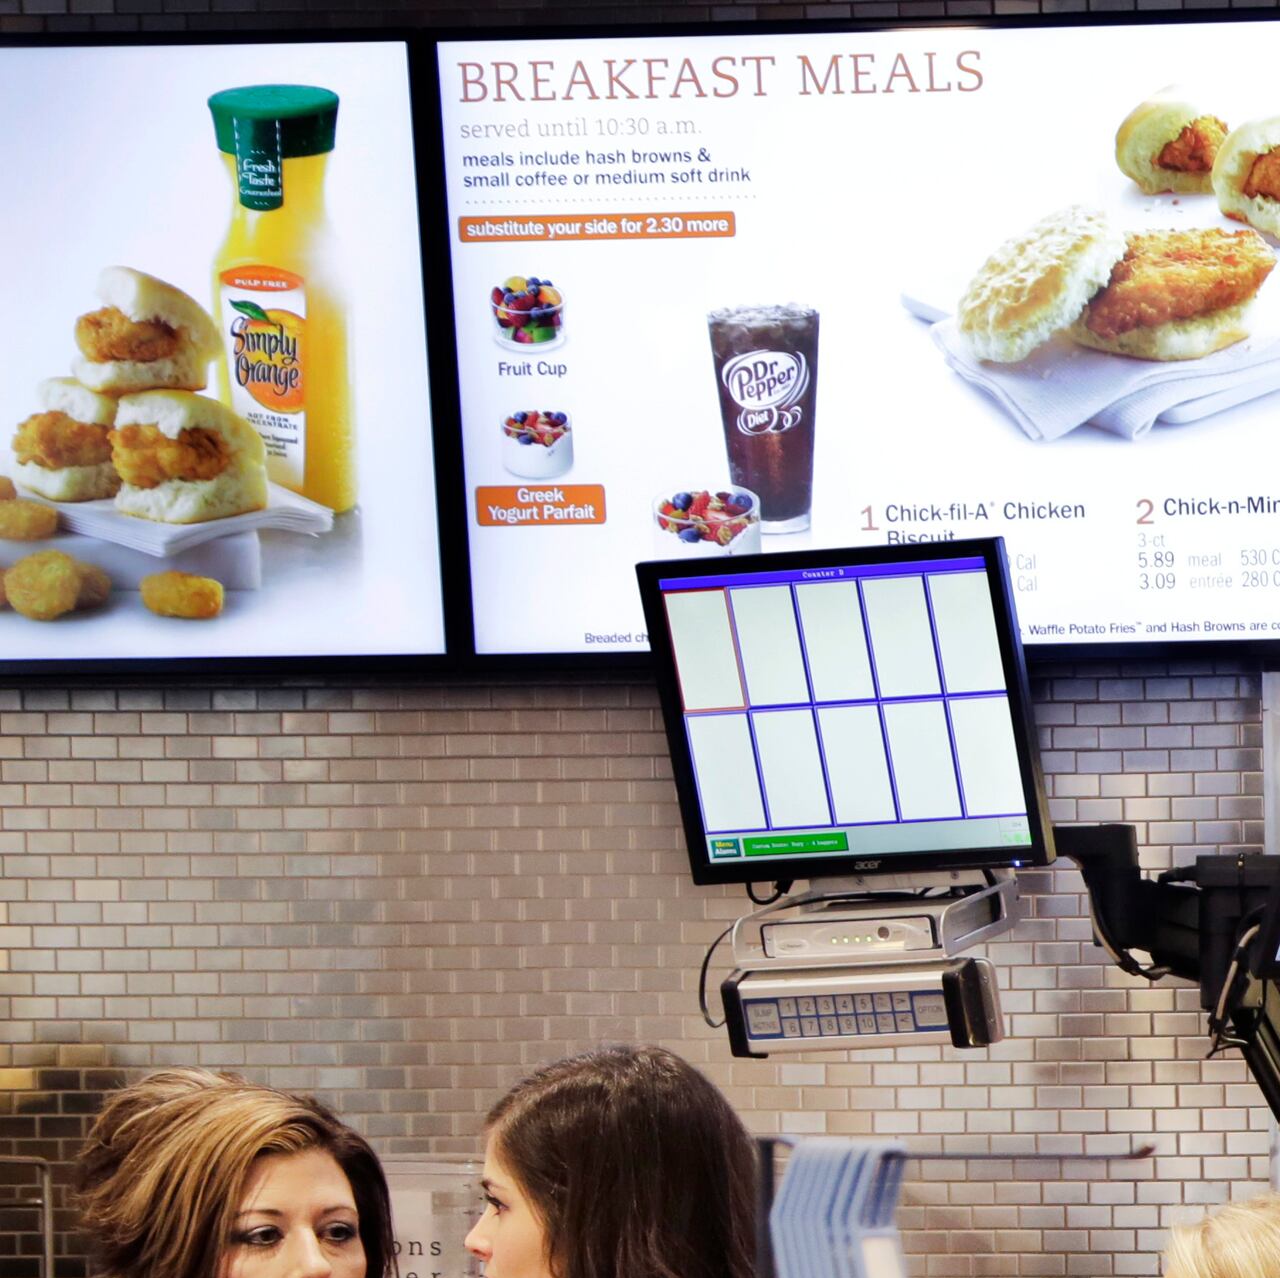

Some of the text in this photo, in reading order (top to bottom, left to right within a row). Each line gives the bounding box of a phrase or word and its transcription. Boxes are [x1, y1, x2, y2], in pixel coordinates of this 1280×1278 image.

[457, 51, 983, 103] BREAKFAST MEALS
[460, 117, 701, 139] served until 10:30 a.m.
[243, 159, 276, 174] Fresh
[463, 148, 711, 167] meals include hash browns &
[242, 172, 275, 187] Taste
[464, 168, 750, 187] small coffee or medium soft drink
[467, 217, 729, 238] substitute your side for 2.30 more
[231, 316, 298, 365] Simply
[234, 352, 300, 397] Orange
[498, 361, 567, 378] Fruit Cup
[752, 359, 780, 384] Dr
[737, 367, 797, 401] Pepper
[747, 410, 769, 426] Diet
[517, 488, 564, 504] Greek
[488, 504, 595, 523] Yogurt Parfait
[861, 505, 879, 531] 1
[1004, 502, 1085, 520] Chicken
[1136, 499, 1154, 524] 2
[887, 530, 956, 545] Biscuit
[1139, 551, 1174, 568] 5.89
[1241, 549, 1267, 566] 530
[802, 571, 832, 580] Counter
[1140, 573, 1175, 590] 3.09
[1242, 571, 1268, 587] 280
[1029, 624, 1106, 635] Waffle Potato
[854, 860, 882, 870] acer
